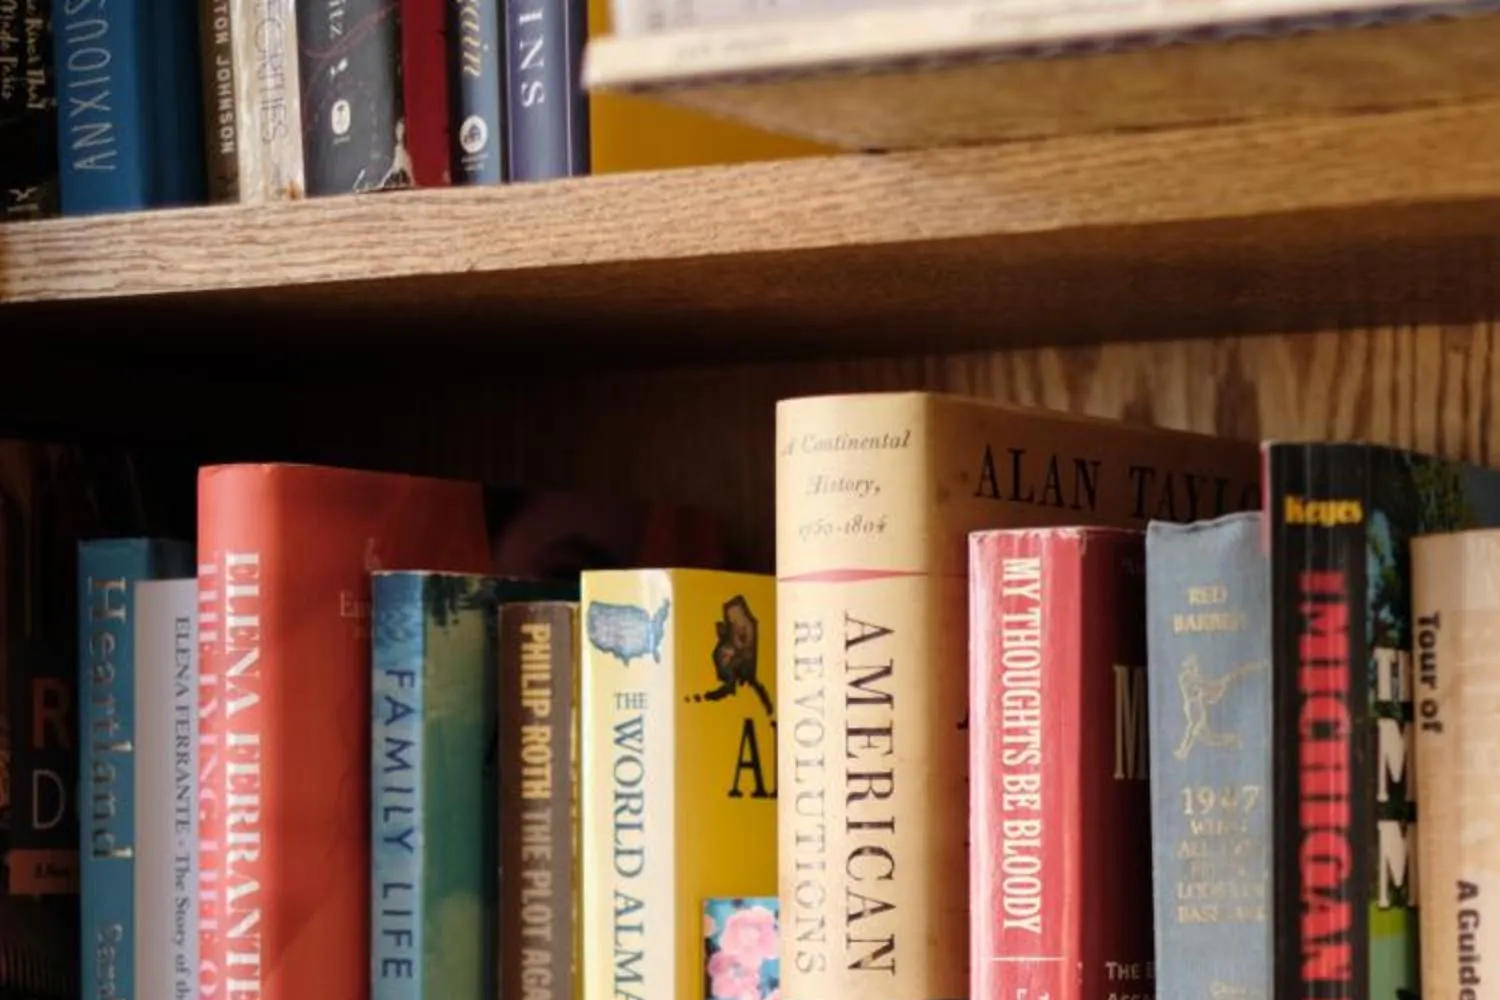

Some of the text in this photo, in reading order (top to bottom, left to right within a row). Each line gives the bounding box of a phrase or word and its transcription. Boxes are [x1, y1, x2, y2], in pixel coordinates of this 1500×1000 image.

[213, 0, 236, 155] TON JOHNSON
[460, 0, 492, 79] ain
[801, 430, 911, 454] Continental
[973, 443, 1101, 513] ALAN
[806, 474, 882, 498] History,
[175, 616, 191, 698] ELENA
[225, 551, 262, 720] ELENA
[520, 623, 552, 717] PHILIP
[1418, 610, 1444, 734] Tour of
[88, 575, 135, 861] Heartland
[614, 690, 649, 711] THE
[175, 704, 191, 833] FERRANTE
[520, 726, 552, 800] ROTH
[1002, 557, 1042, 934] MY THOUGHTS BE BLOODY
[381, 669, 415, 980] FAMILY LIFE
[613, 716, 645, 879] WORLD
[793, 620, 826, 975] REVOLUTIONS
[845, 610, 896, 974] AMERICAN
[1300, 600, 1352, 980] MICHIGAN
[175, 854, 191, 891] The
[521, 808, 553, 862] THE
[171, 896, 191, 946] Story
[521, 870, 553, 943] PLOT
[1456, 879, 1480, 903] A
[175, 953, 191, 979] of
[1104, 961, 1141, 981] THE
